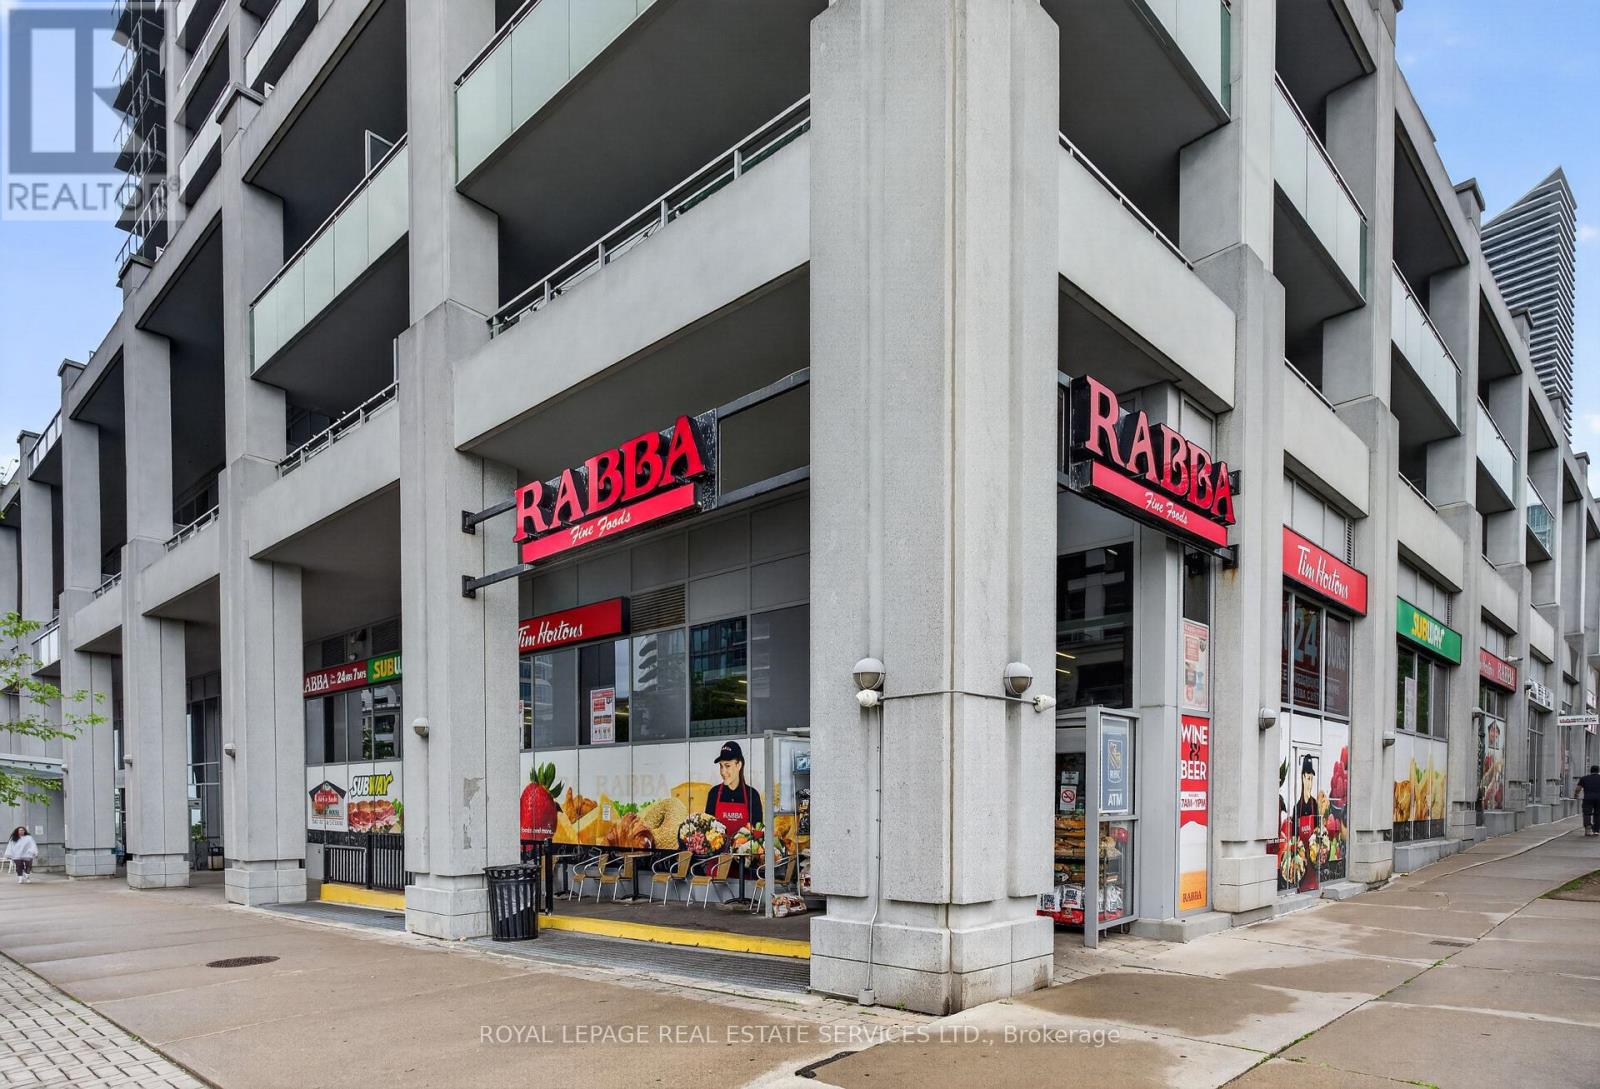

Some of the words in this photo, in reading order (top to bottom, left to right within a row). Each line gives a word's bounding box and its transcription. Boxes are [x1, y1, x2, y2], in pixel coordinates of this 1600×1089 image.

[1085, 374, 1236, 525] RABBA
[512, 415, 705, 543] RABBA
[1144, 491, 1164, 513] Fine
[1165, 501, 1189, 525] Foods
[570, 524, 594, 546] Fine
[597, 510, 631, 538] Foods
[1297, 545, 1315, 583] Tim
[1316, 553, 1350, 600] Hortons
[518, 625, 535, 648] Tim
[537, 620, 584, 645] Hortons
[1294, 607, 1318, 666] 24
[1411, 611, 1445, 650] SUBWAY
[304, 673, 330, 693] ABBA
[372, 655, 402, 680] SUBW
[1181, 724, 1208, 745] WINE
[349, 771, 393, 798] SUBWAY
[1180, 760, 1207, 780] BEER
[1107, 793, 1123, 807] ATM
